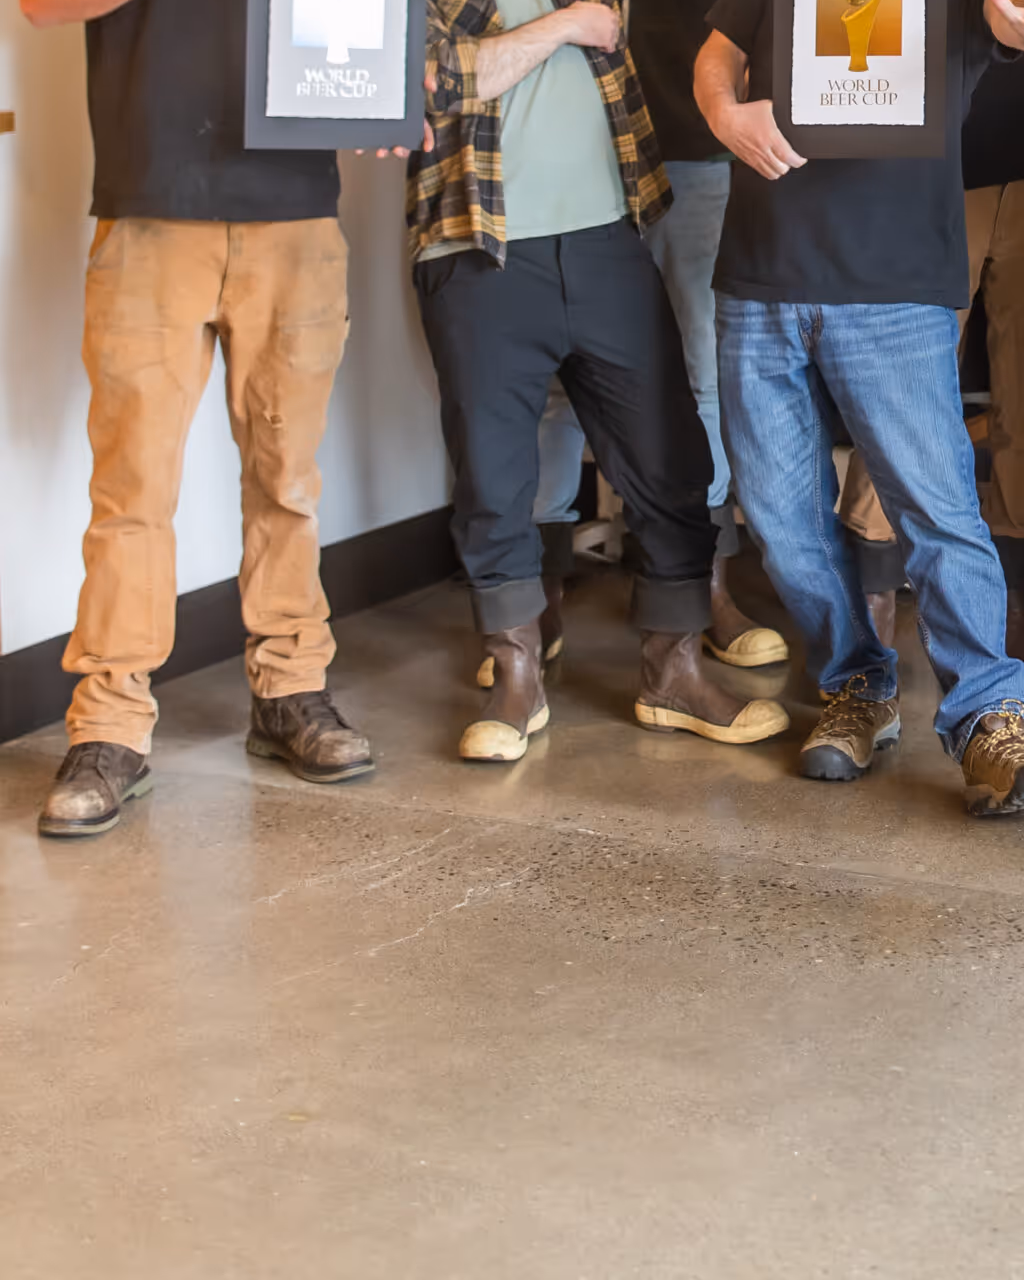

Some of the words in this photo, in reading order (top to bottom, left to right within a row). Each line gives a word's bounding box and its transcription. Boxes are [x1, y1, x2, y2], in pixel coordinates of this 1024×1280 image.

[340, 81, 377, 98] CUP
[828, 79, 890, 92] WORLD
[820, 92, 858, 106] BEER
[862, 92, 898, 106] CUP
